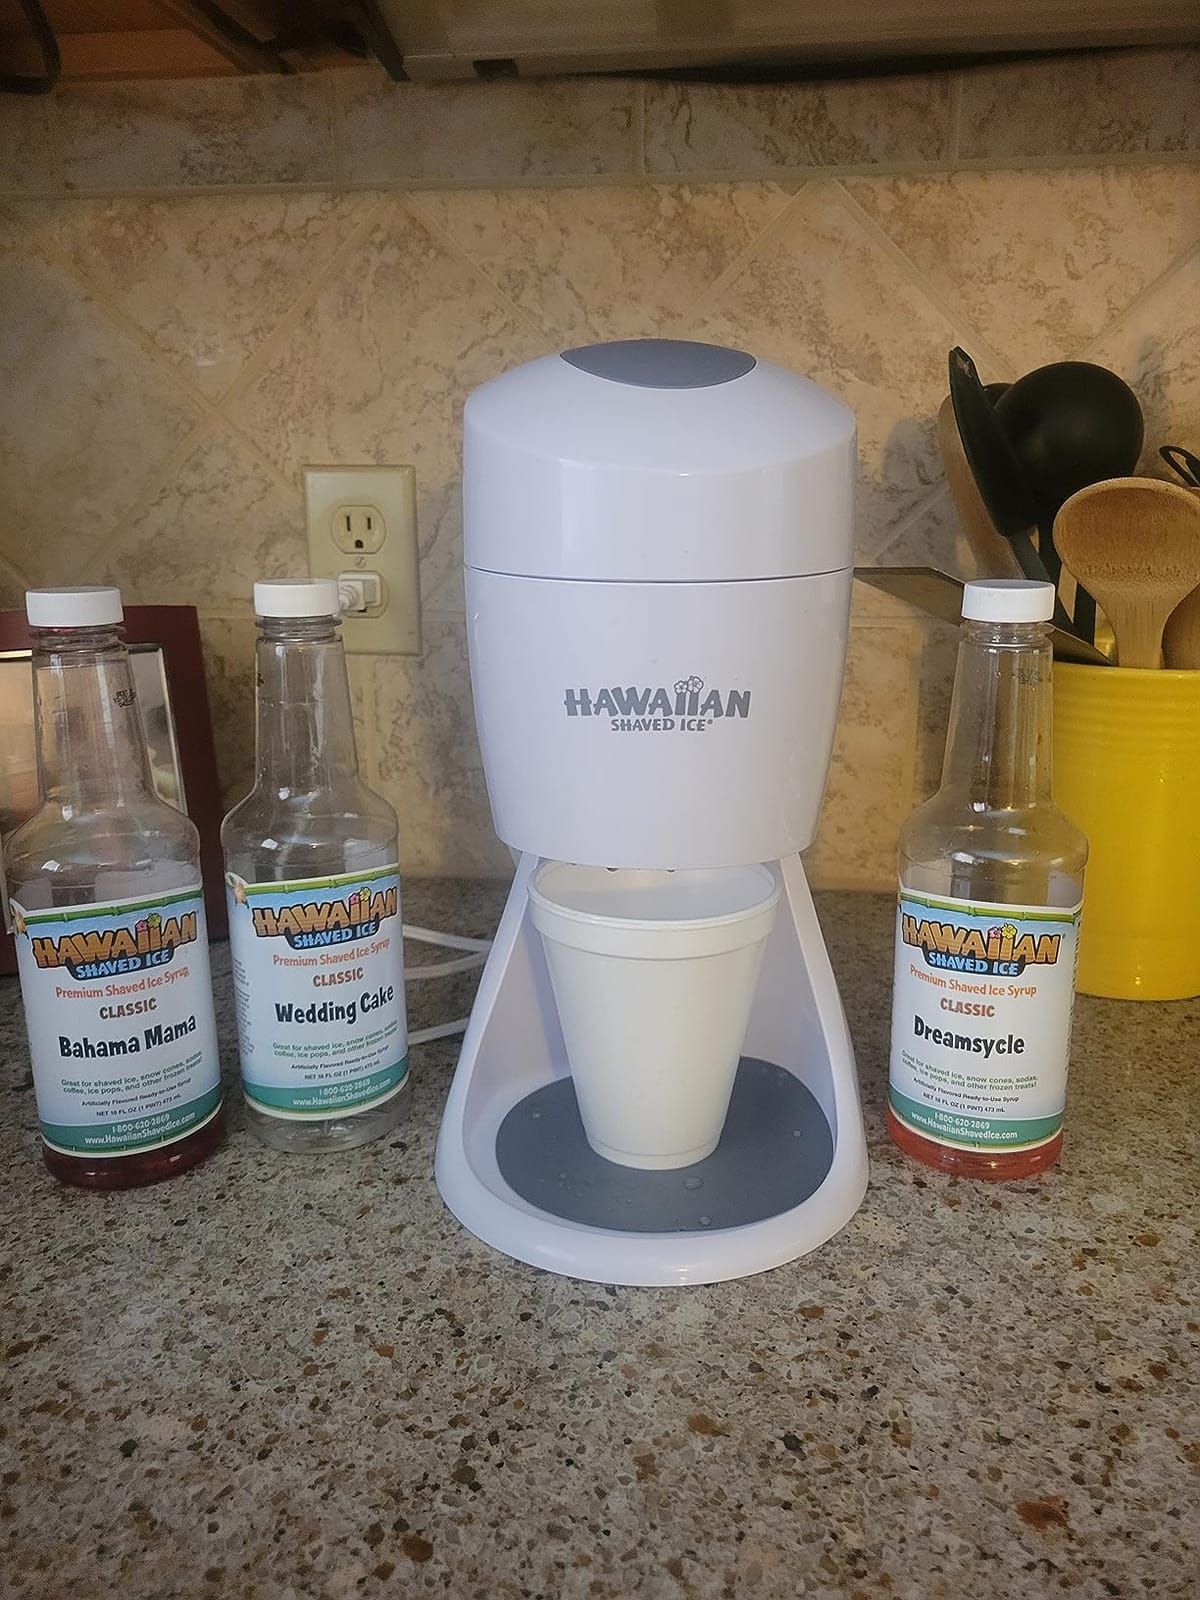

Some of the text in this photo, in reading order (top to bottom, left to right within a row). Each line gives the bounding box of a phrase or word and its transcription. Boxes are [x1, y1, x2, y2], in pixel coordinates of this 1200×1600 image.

[564, 681, 750, 718] HAWAIIAN
[612, 718, 674, 731] SHAVED
[254, 887, 397, 936] HAWAIIAN
[32, 911, 197, 968] HAWAIIAN
[293, 921, 376, 948] SHAVED ICE
[901, 913, 1060, 965] HAWAIIAN
[76, 950, 170, 979] SHAVED ICE
[273, 937, 390, 967] Premium Shaved Ice Syrup
[929, 951, 1018, 975] SHAVED ICE
[56, 967, 189, 999] Premium Shaved Ice Syrup
[313, 966, 364, 987] CLASSIC
[910, 964, 1037, 997] Premium Shaved Ice Syrup
[99, 998, 157, 1020] CLASSIC
[275, 984, 394, 1025] Wedding Cake
[940, 997, 995, 1017] CLASSIC
[59, 1014, 197, 1059] Bahama Mama
[303, 1043, 330, 1051] shaved
[346, 1036, 364, 1046] snow
[347, 1042, 365, 1052] other
[914, 1015, 1025, 1058] Dreamsycle
[61, 1079, 79, 1087] Great
[124, 1075, 139, 1084] ice,
[140, 1071, 161, 1081] snow
[916, 1058, 924, 1066] for
[925, 1063, 949, 1076] shaved
[920, 1068, 928, 1076] ice
[951, 1078, 965, 1086] and
[88, 1086, 99, 1094] ice
[101, 1086, 124, 1095] pops,
[142, 1077, 162, 1088] other
[164, 1068, 185, 1081] frozen
[82, 1098, 110, 1107] Artificially
[112, 1095, 138, 1105] Flavored
[85, 1112, 195, 1144] www.HawaiianShavedIce.com
[912, 1112, 1018, 1138] www.HawaiianShavedIce.com
